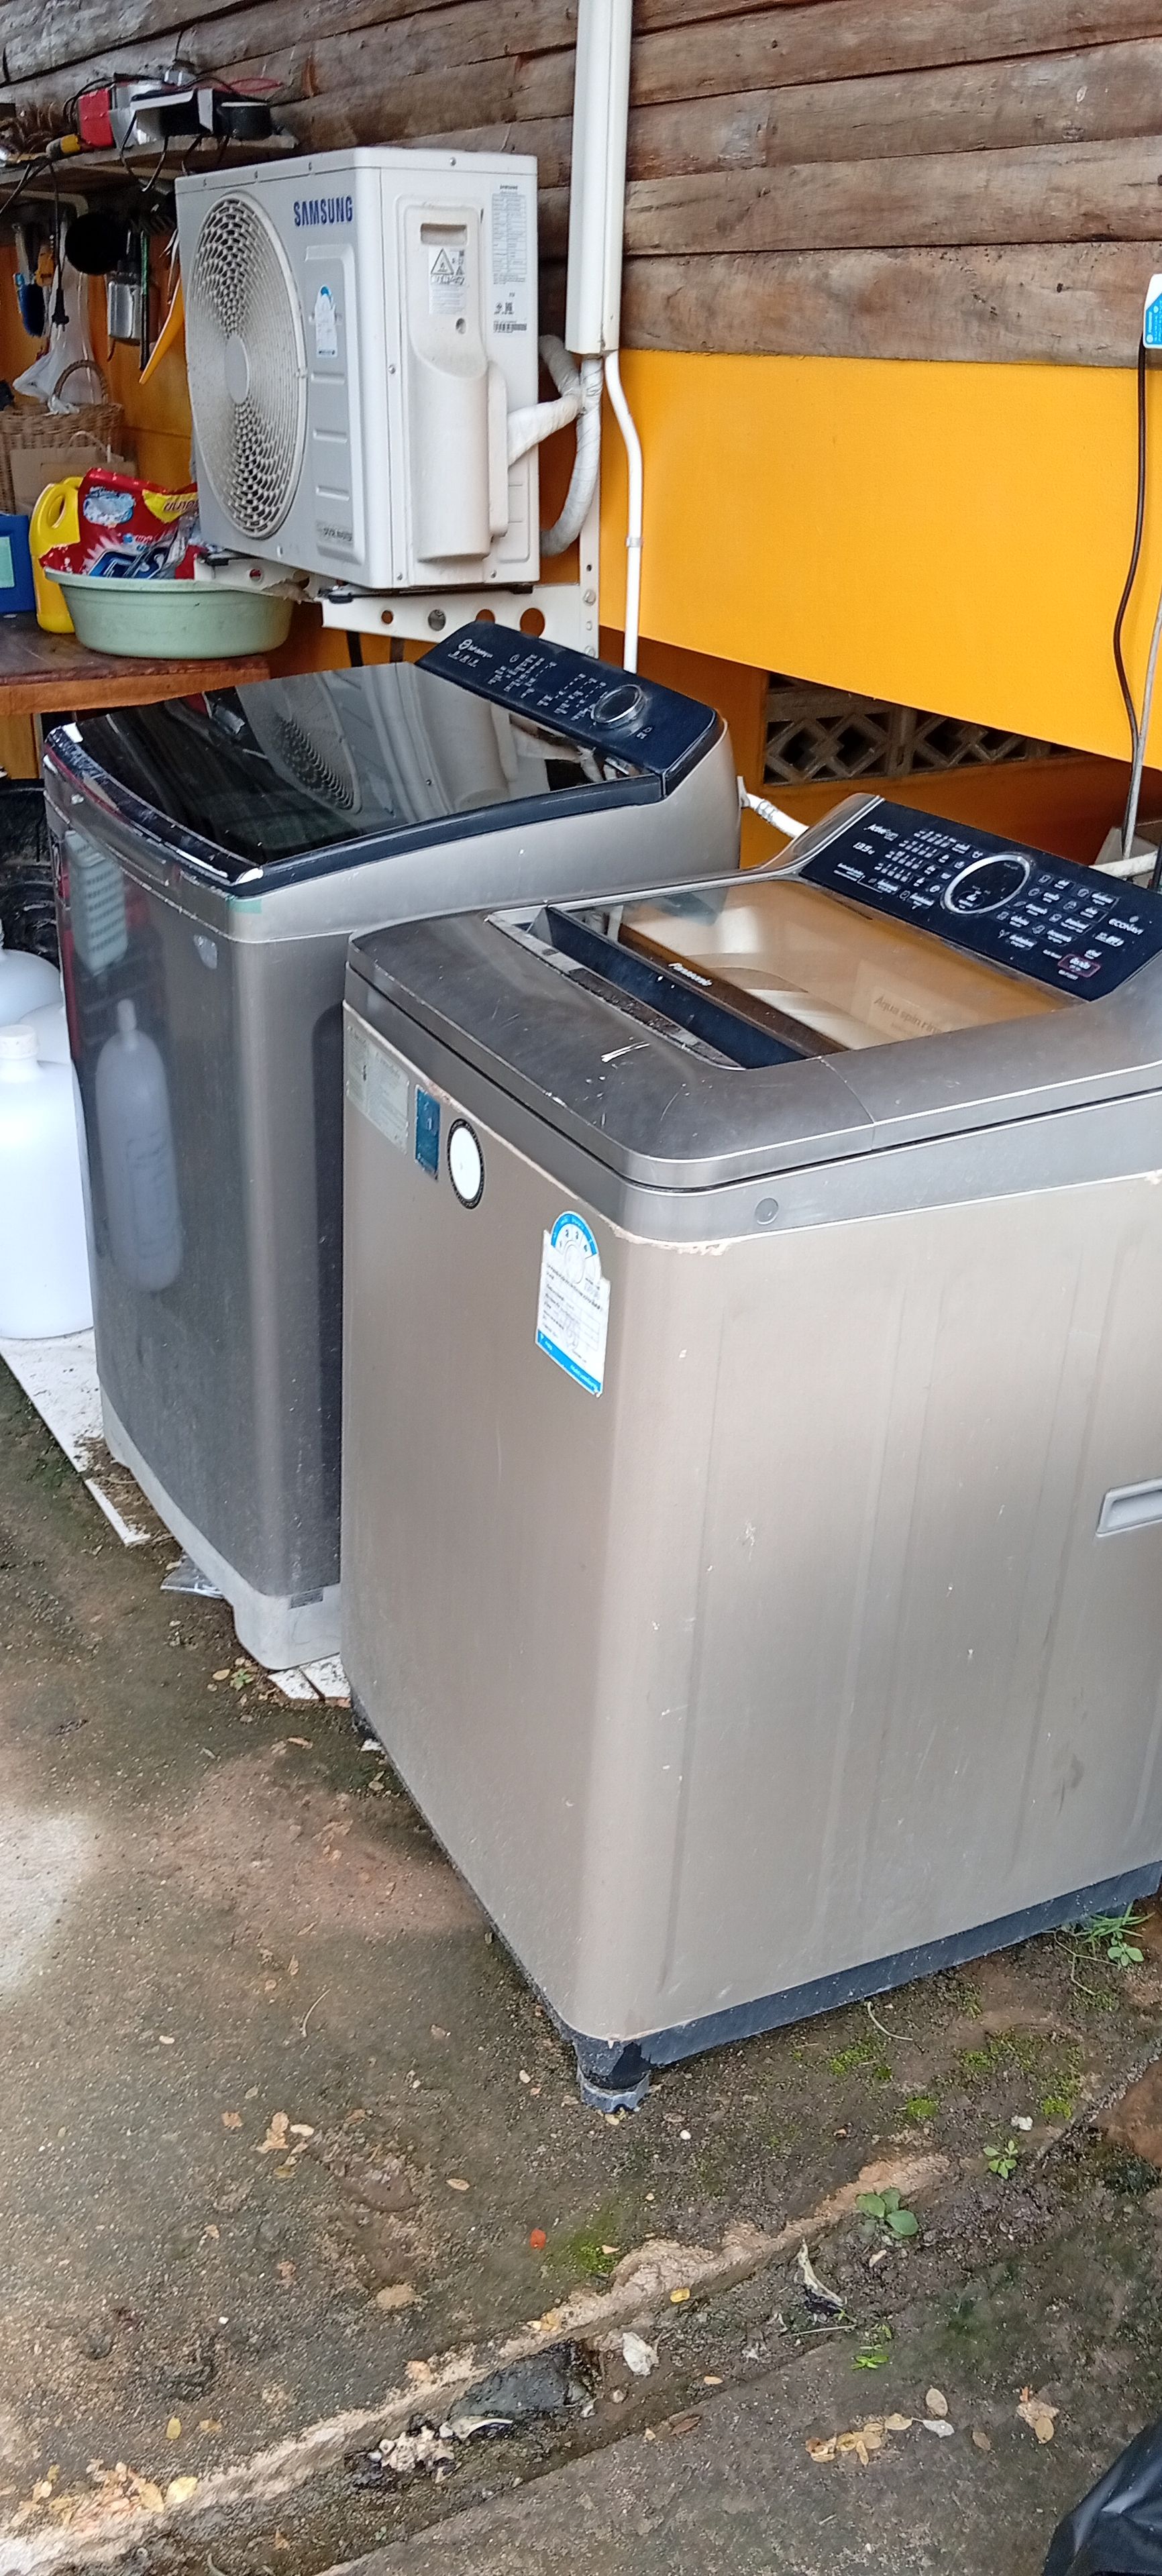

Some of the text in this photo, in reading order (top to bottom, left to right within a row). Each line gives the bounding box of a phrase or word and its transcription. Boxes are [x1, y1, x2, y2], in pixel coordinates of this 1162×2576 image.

[293, 195, 353, 226] SAMSUNG
[668, 963, 712, 986] Panasonic
[874, 994, 900, 1016] Aqua
[900, 1011, 922, 1027] spin
